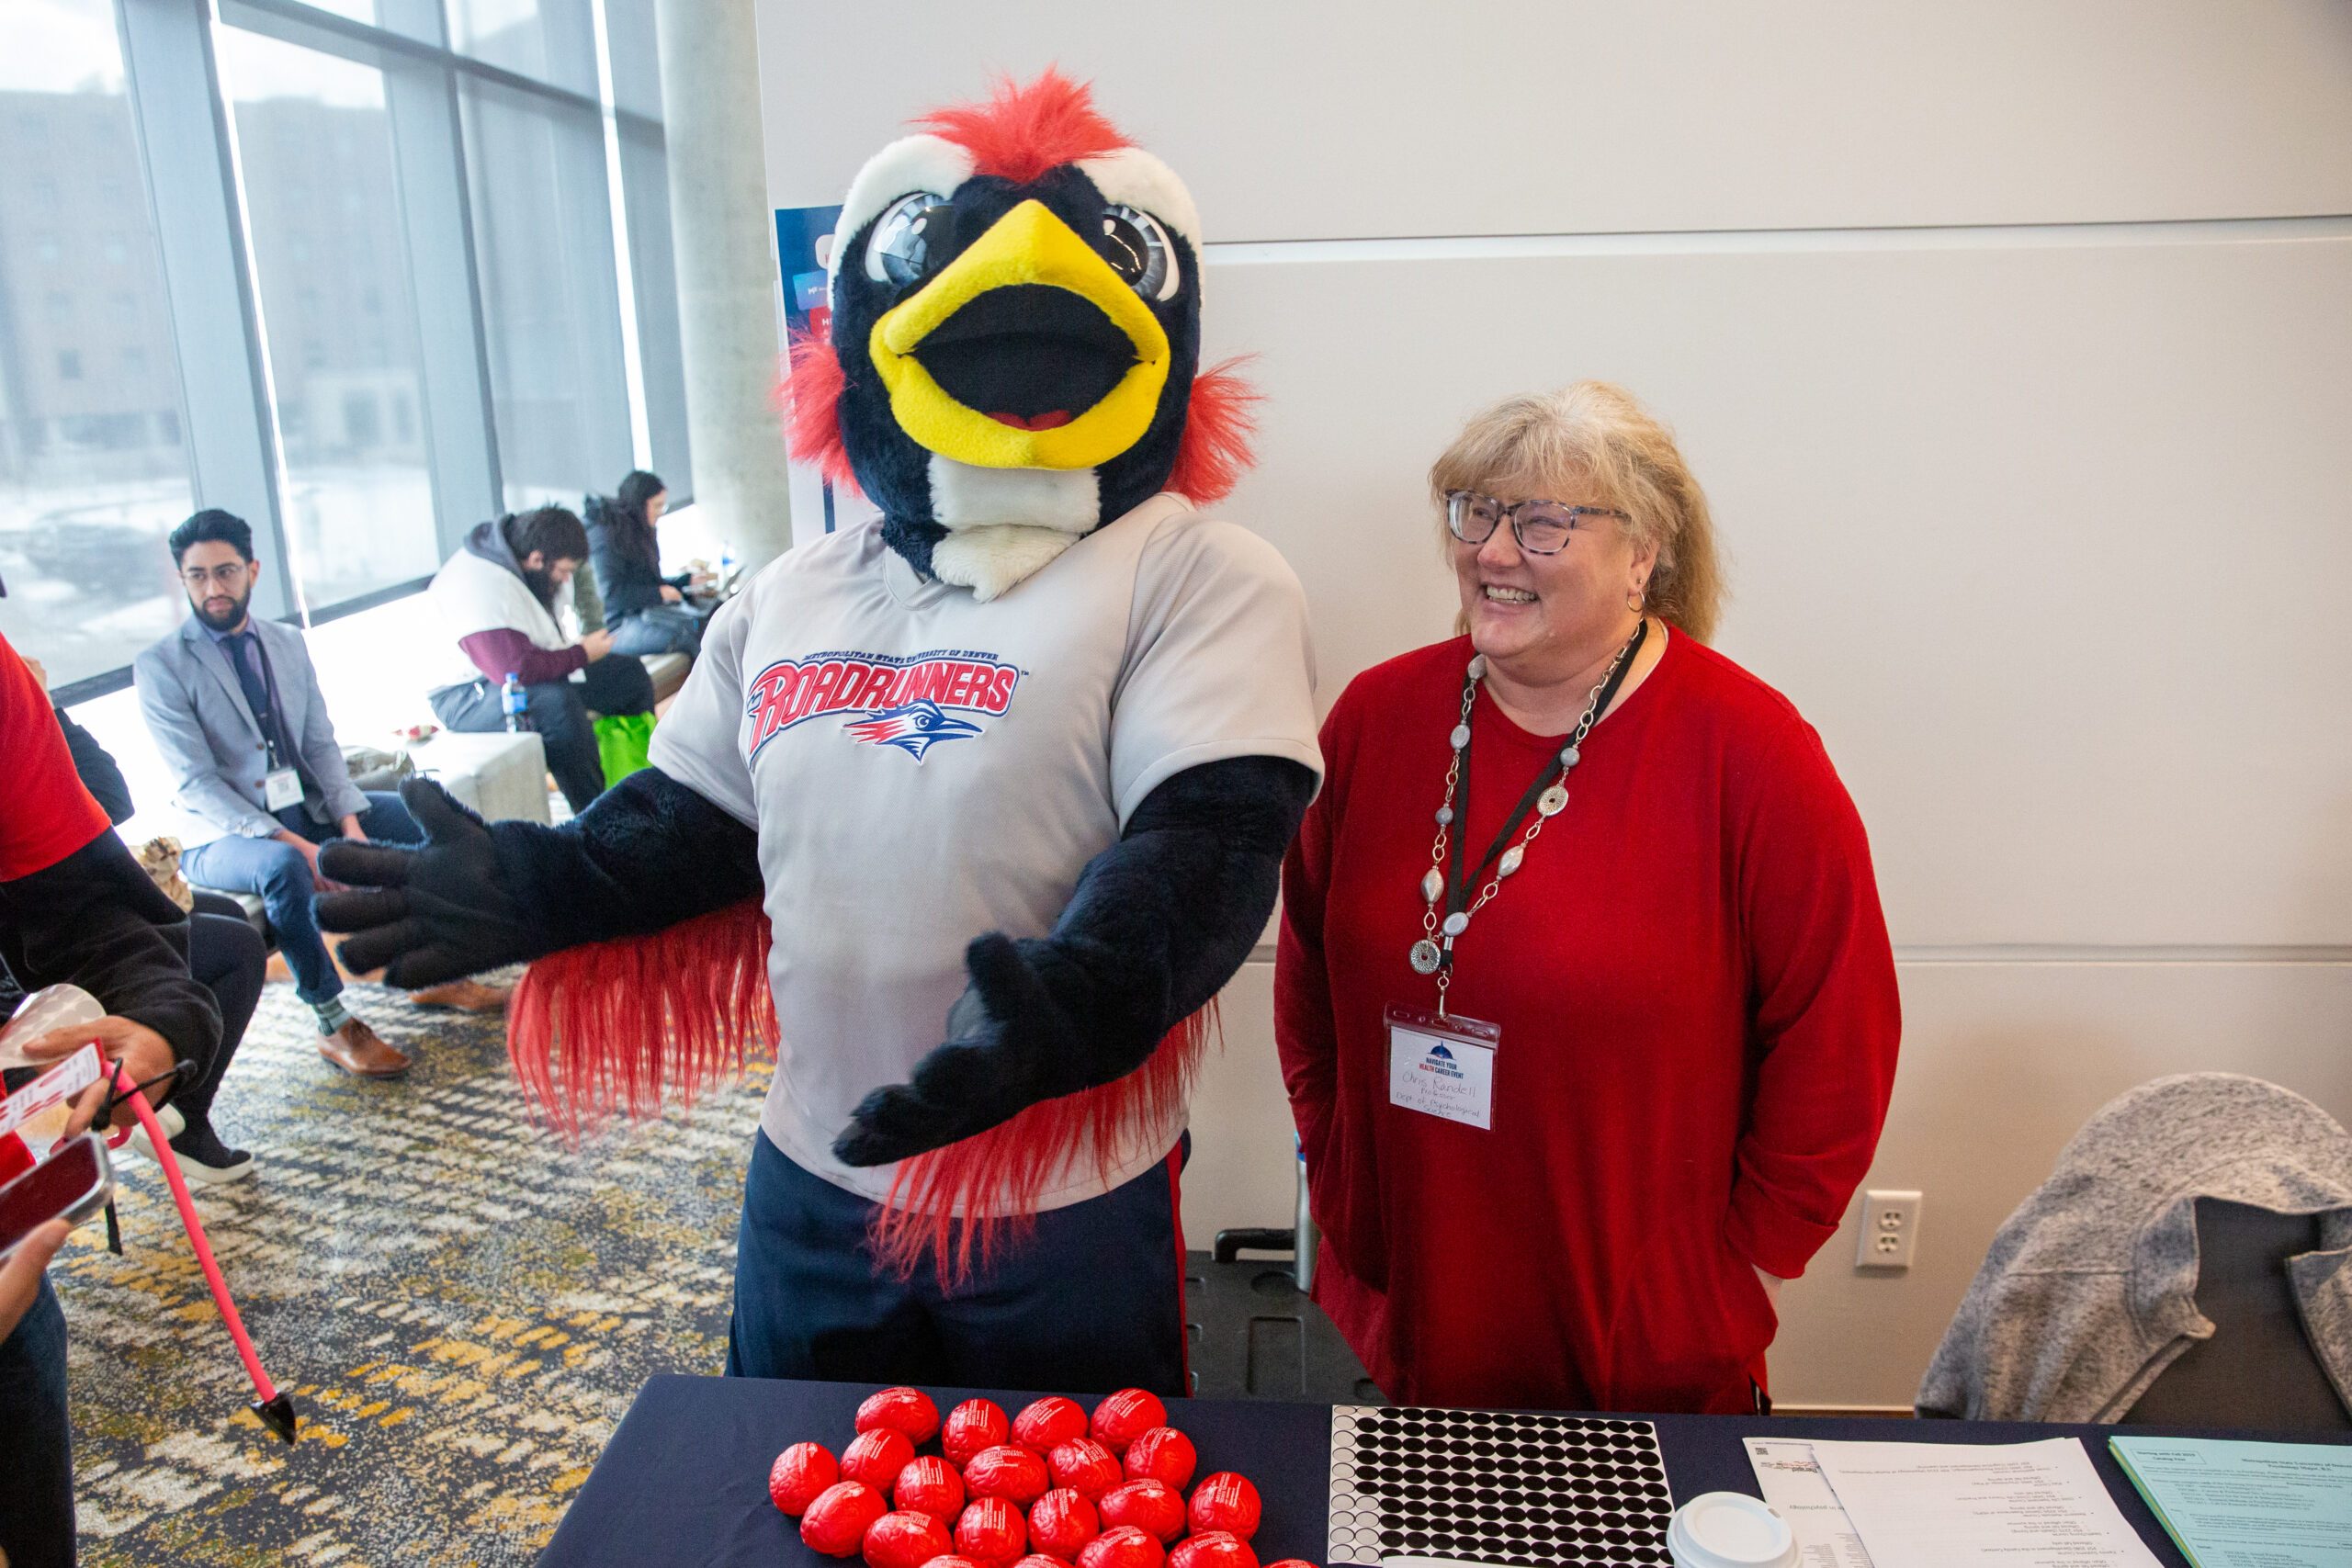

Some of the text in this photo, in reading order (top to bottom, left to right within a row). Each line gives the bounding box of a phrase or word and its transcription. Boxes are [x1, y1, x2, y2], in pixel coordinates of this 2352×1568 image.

[802, 649, 999, 663] METROPOLITAN STATE UNIVERSITY OF DENVER
[747, 659, 1019, 769] ROADRUNNERS
[1419, 1063, 1464, 1079] HEALTH CAREER EVENT
[1426, 1057, 1457, 1070] NAVIGATE YOUR
